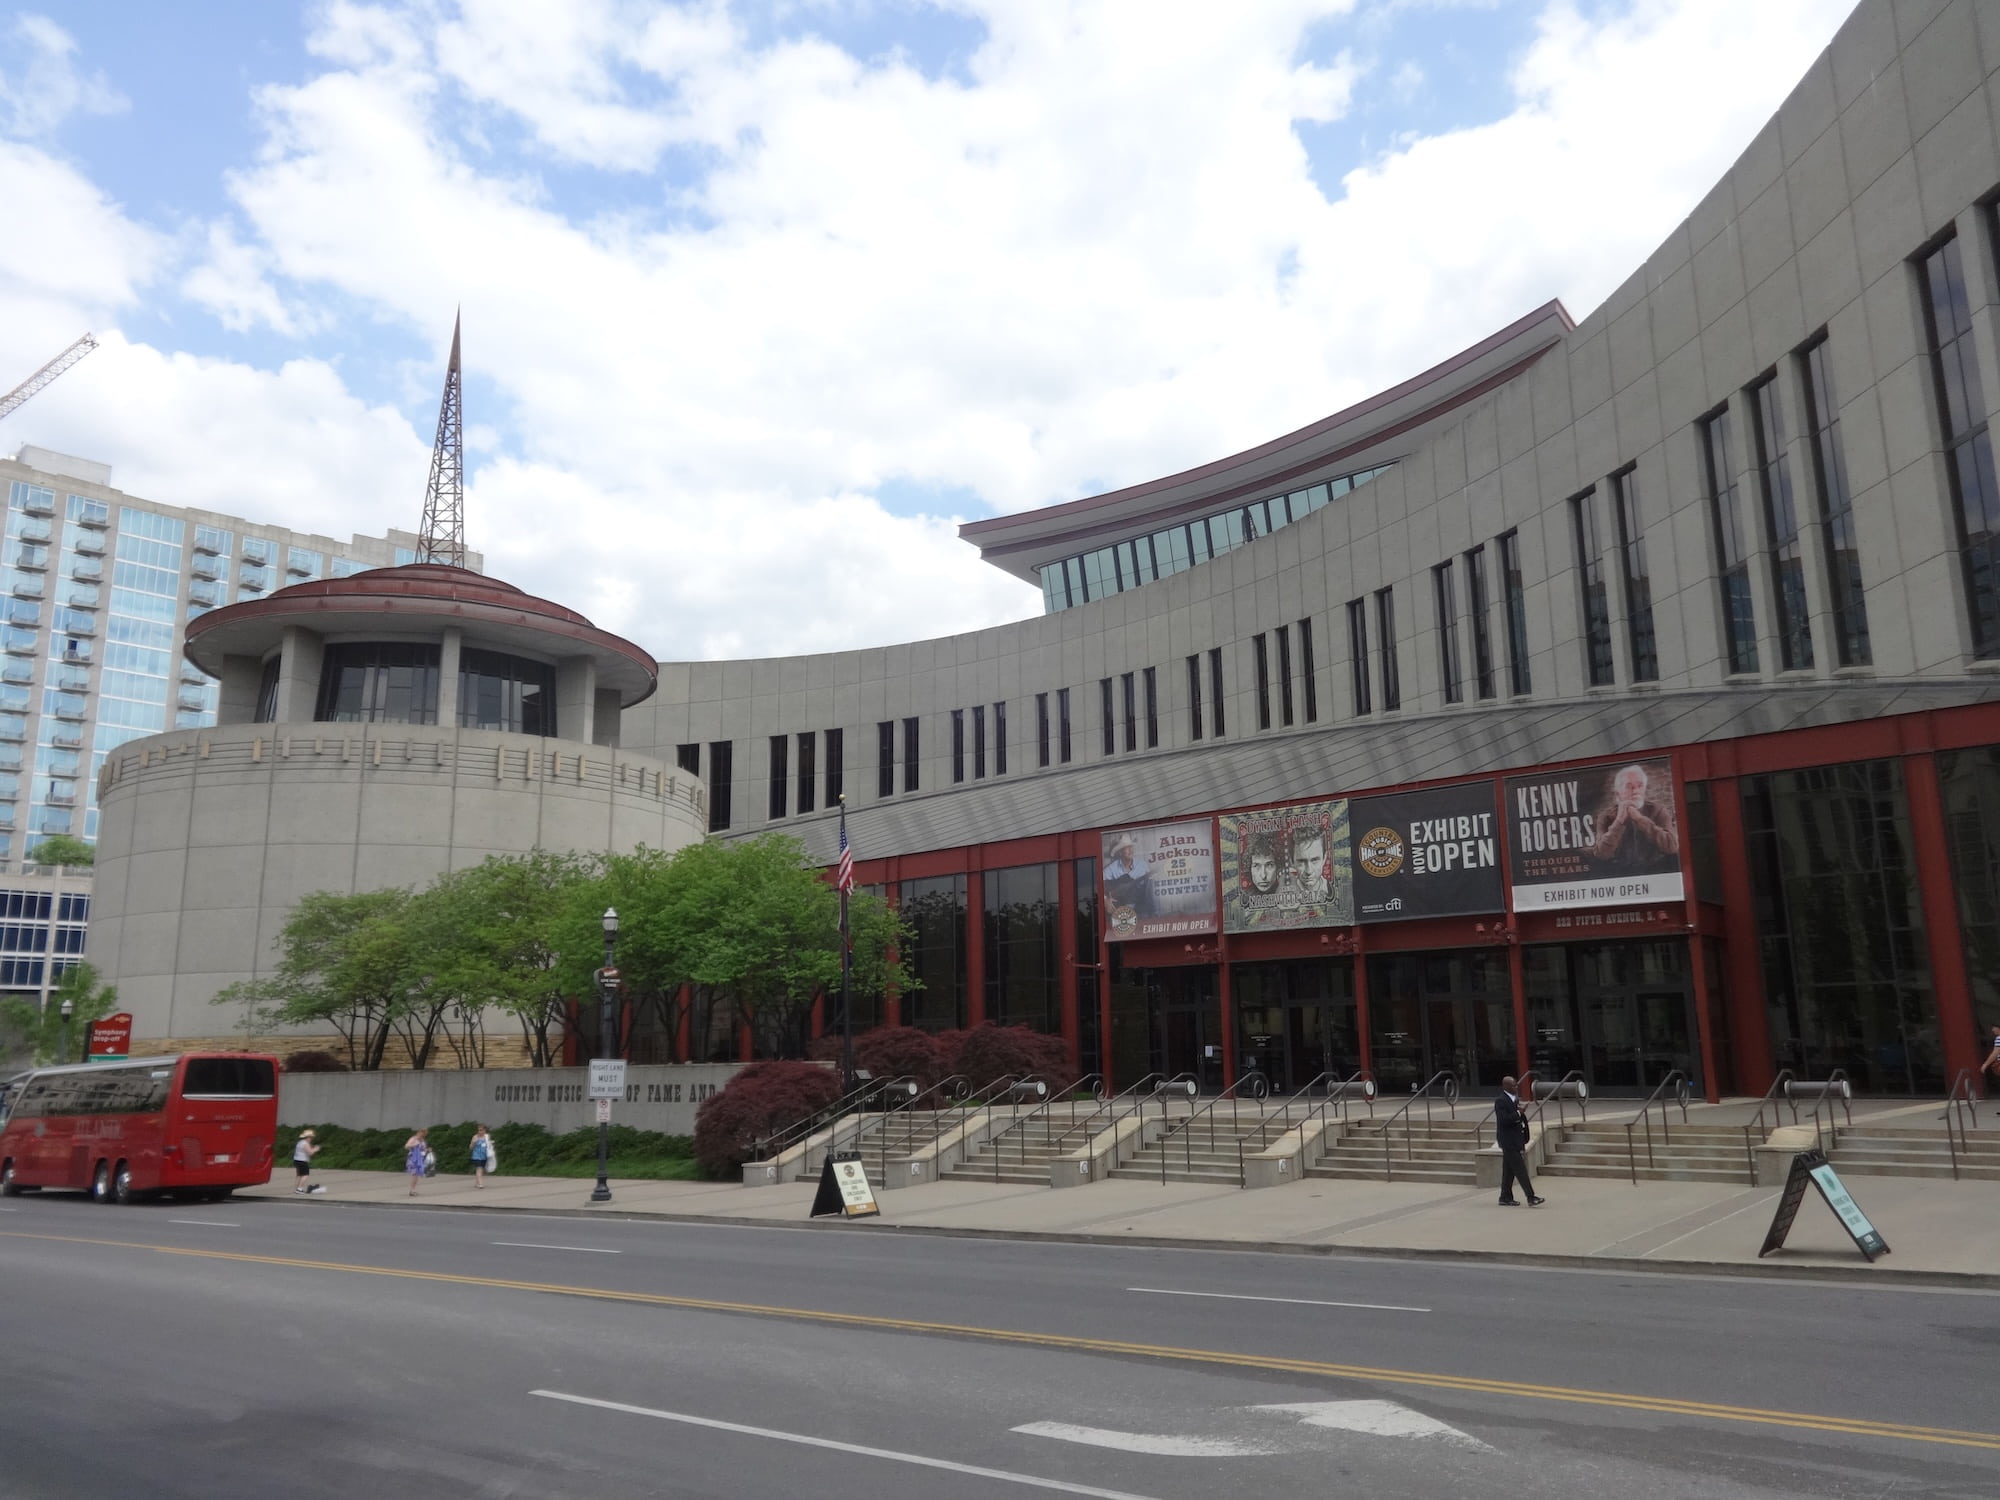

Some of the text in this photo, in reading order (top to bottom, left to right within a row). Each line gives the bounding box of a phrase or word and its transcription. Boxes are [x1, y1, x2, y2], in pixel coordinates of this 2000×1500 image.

[1517, 781, 1578, 818] KENNY
[1410, 813, 1491, 844] EXHIBIT
[1520, 814, 1596, 853] ROGERS
[1160, 835, 1196, 848] Alan
[1148, 847, 1210, 864] Jackson
[1411, 838, 1495, 875] NOW OPEN
[1523, 856, 1580, 867] THROUGH
[1171, 858, 1186, 869] 25
[1524, 864, 1590, 877] THE YEARS
[1197, 875, 1208, 883] IT
[1154, 884, 1208, 897] COUNTRY
[1544, 883, 1649, 902] EXHIBIT NOW OPEN
[1385, 898, 1402, 911] citi
[1143, 919, 1209, 934] EXHIBIT NOW OPEN
[1575, 914, 1602, 926] FIFTH
[598, 1075, 617, 1083] MUST
[495, 1084, 715, 1102] COUNTRY MUSIC OF FAME AND
